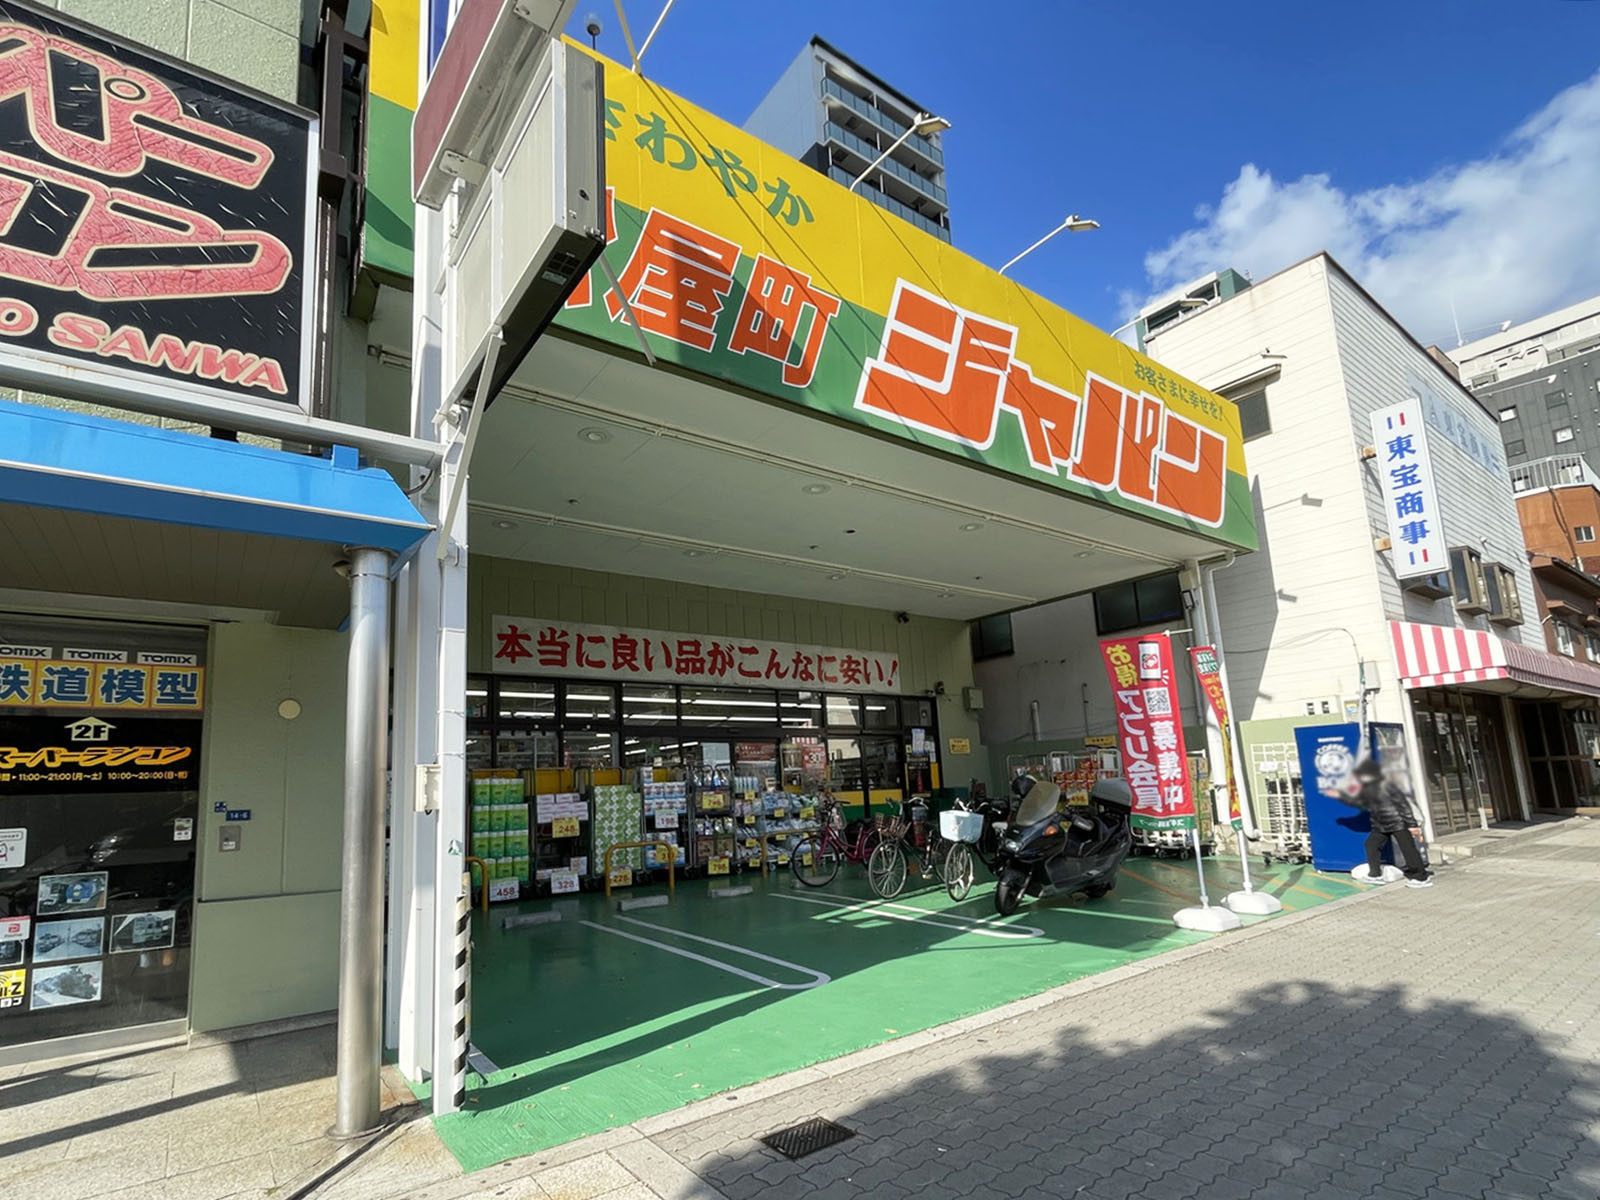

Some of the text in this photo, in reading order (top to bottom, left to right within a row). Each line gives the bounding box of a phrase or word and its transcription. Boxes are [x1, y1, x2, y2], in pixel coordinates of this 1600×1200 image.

[47, 311, 289, 395] SANWA
[564, 186, 1227, 529] 屋町 ジャパン
[1386, 434, 1430, 546] 東宝商事
[0, 646, 192, 664] OMIX TOMIX TOMIX
[74, 724, 107, 739] 2F
[496, 886, 515, 896] 458
